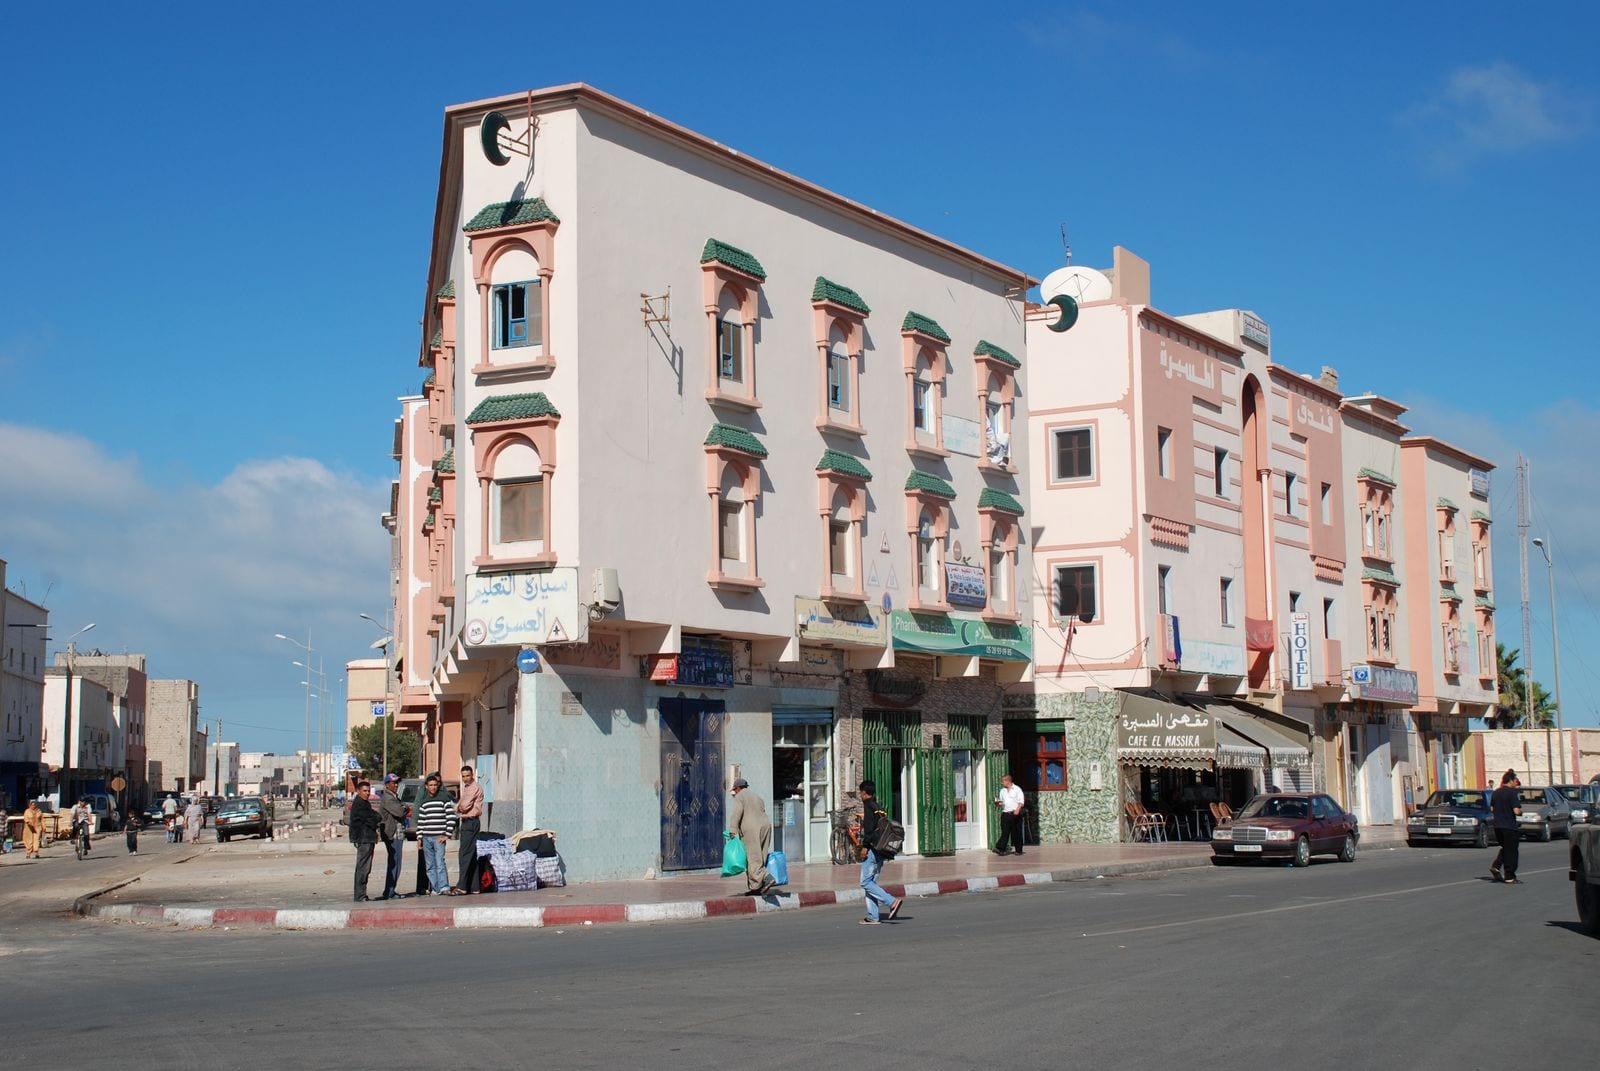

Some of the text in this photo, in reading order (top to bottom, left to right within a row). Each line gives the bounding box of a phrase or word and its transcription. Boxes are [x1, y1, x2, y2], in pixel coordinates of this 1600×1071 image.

[1160, 340, 1214, 390] المسيرة
[1297, 399, 1334, 433] فندق
[467, 572, 567, 604] سيارة التعليم
[1295, 623, 1308, 687] HOTEL
[1122, 712, 1209, 732] مقهى المسيرة
[1128, 735, 1200, 748] CAFE EL MASSIRA
